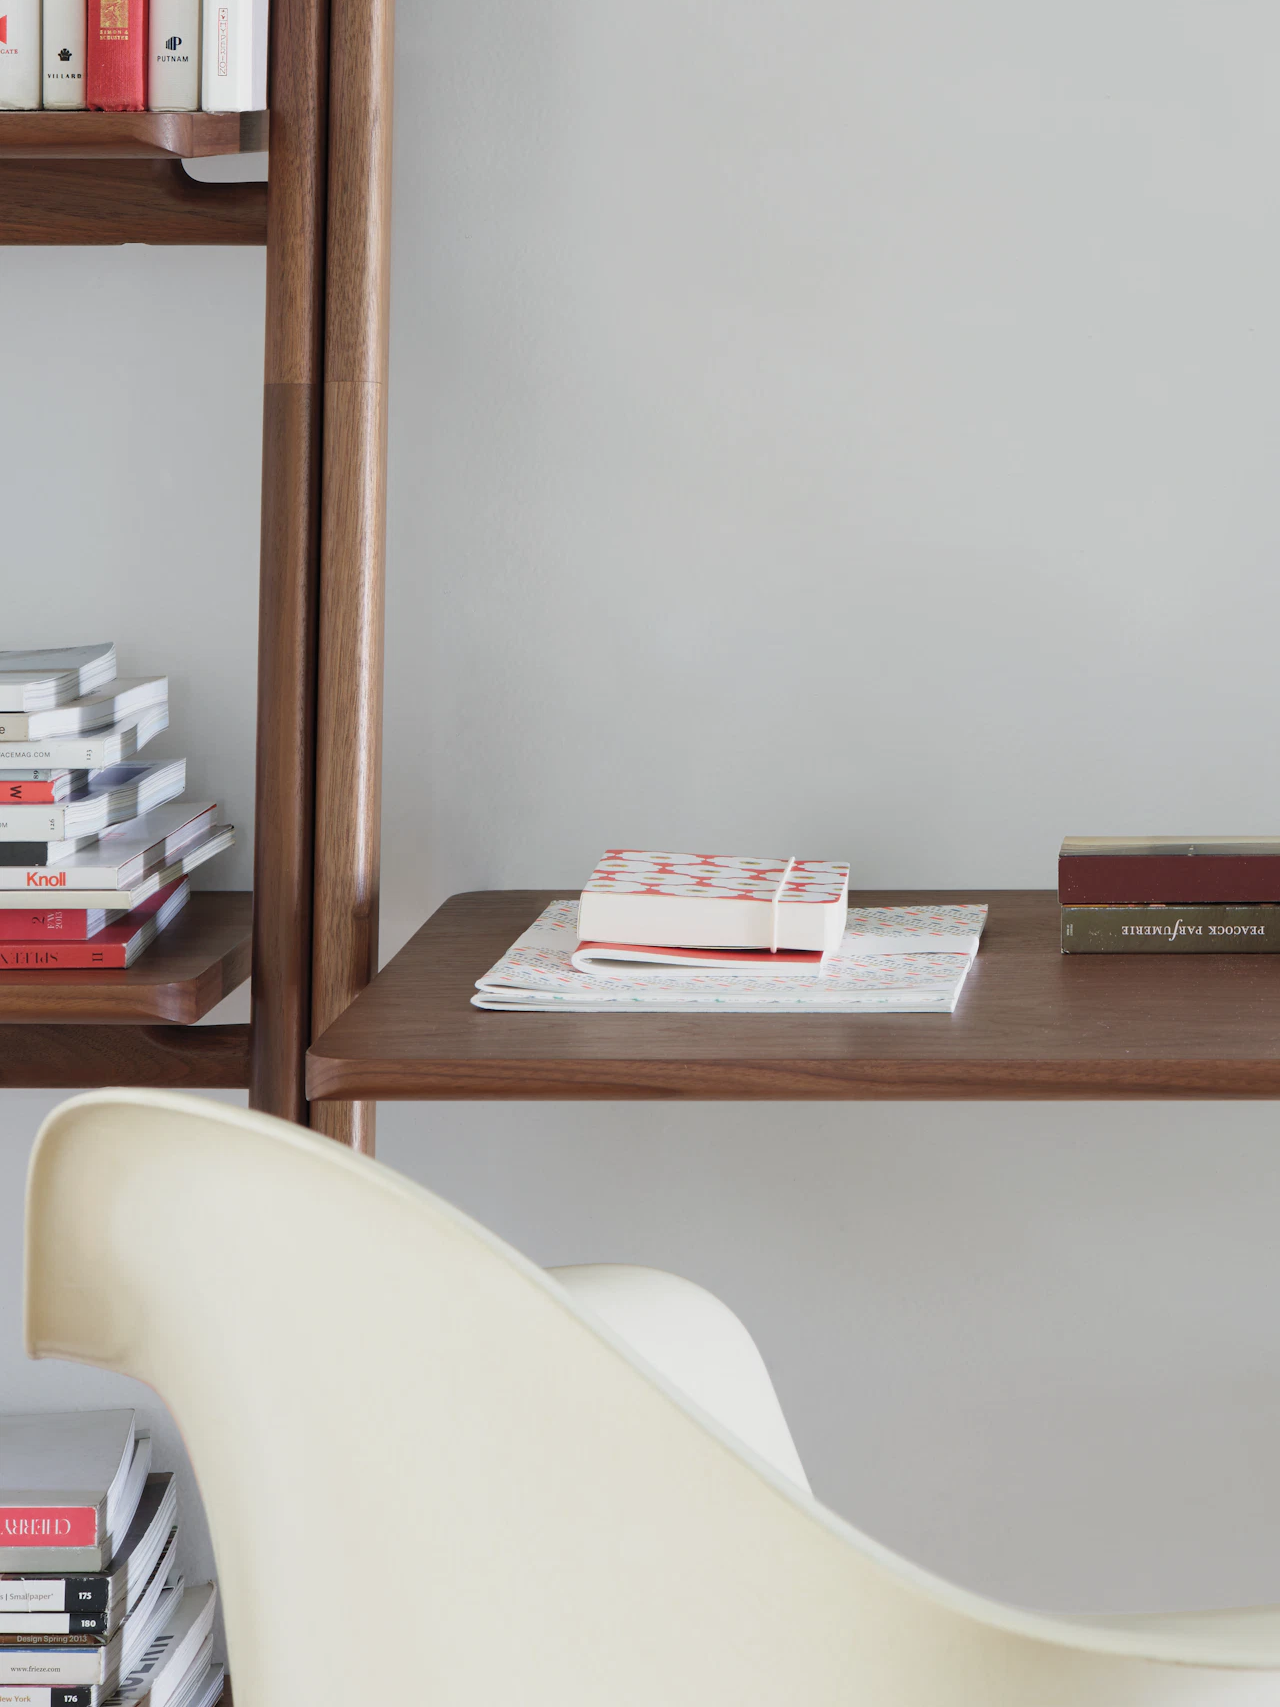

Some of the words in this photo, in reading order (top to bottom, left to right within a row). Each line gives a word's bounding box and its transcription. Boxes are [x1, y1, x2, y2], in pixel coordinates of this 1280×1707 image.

[157, 55, 189, 63] PUTNAM
[26, 871, 67, 887] Knoll
[55, 911, 63, 930] 2013
[1208, 925, 1265, 935] PEACOCK
[78, 1592, 92, 1600] 175
[81, 1620, 96, 1628] 180
[16, 1635, 43, 1644] Design
[43, 1635, 68, 1644] Spring
[69, 1634, 88, 1643] 2013
[14, 1695, 32, 1703] York
[64, 1695, 78, 1703] 176
